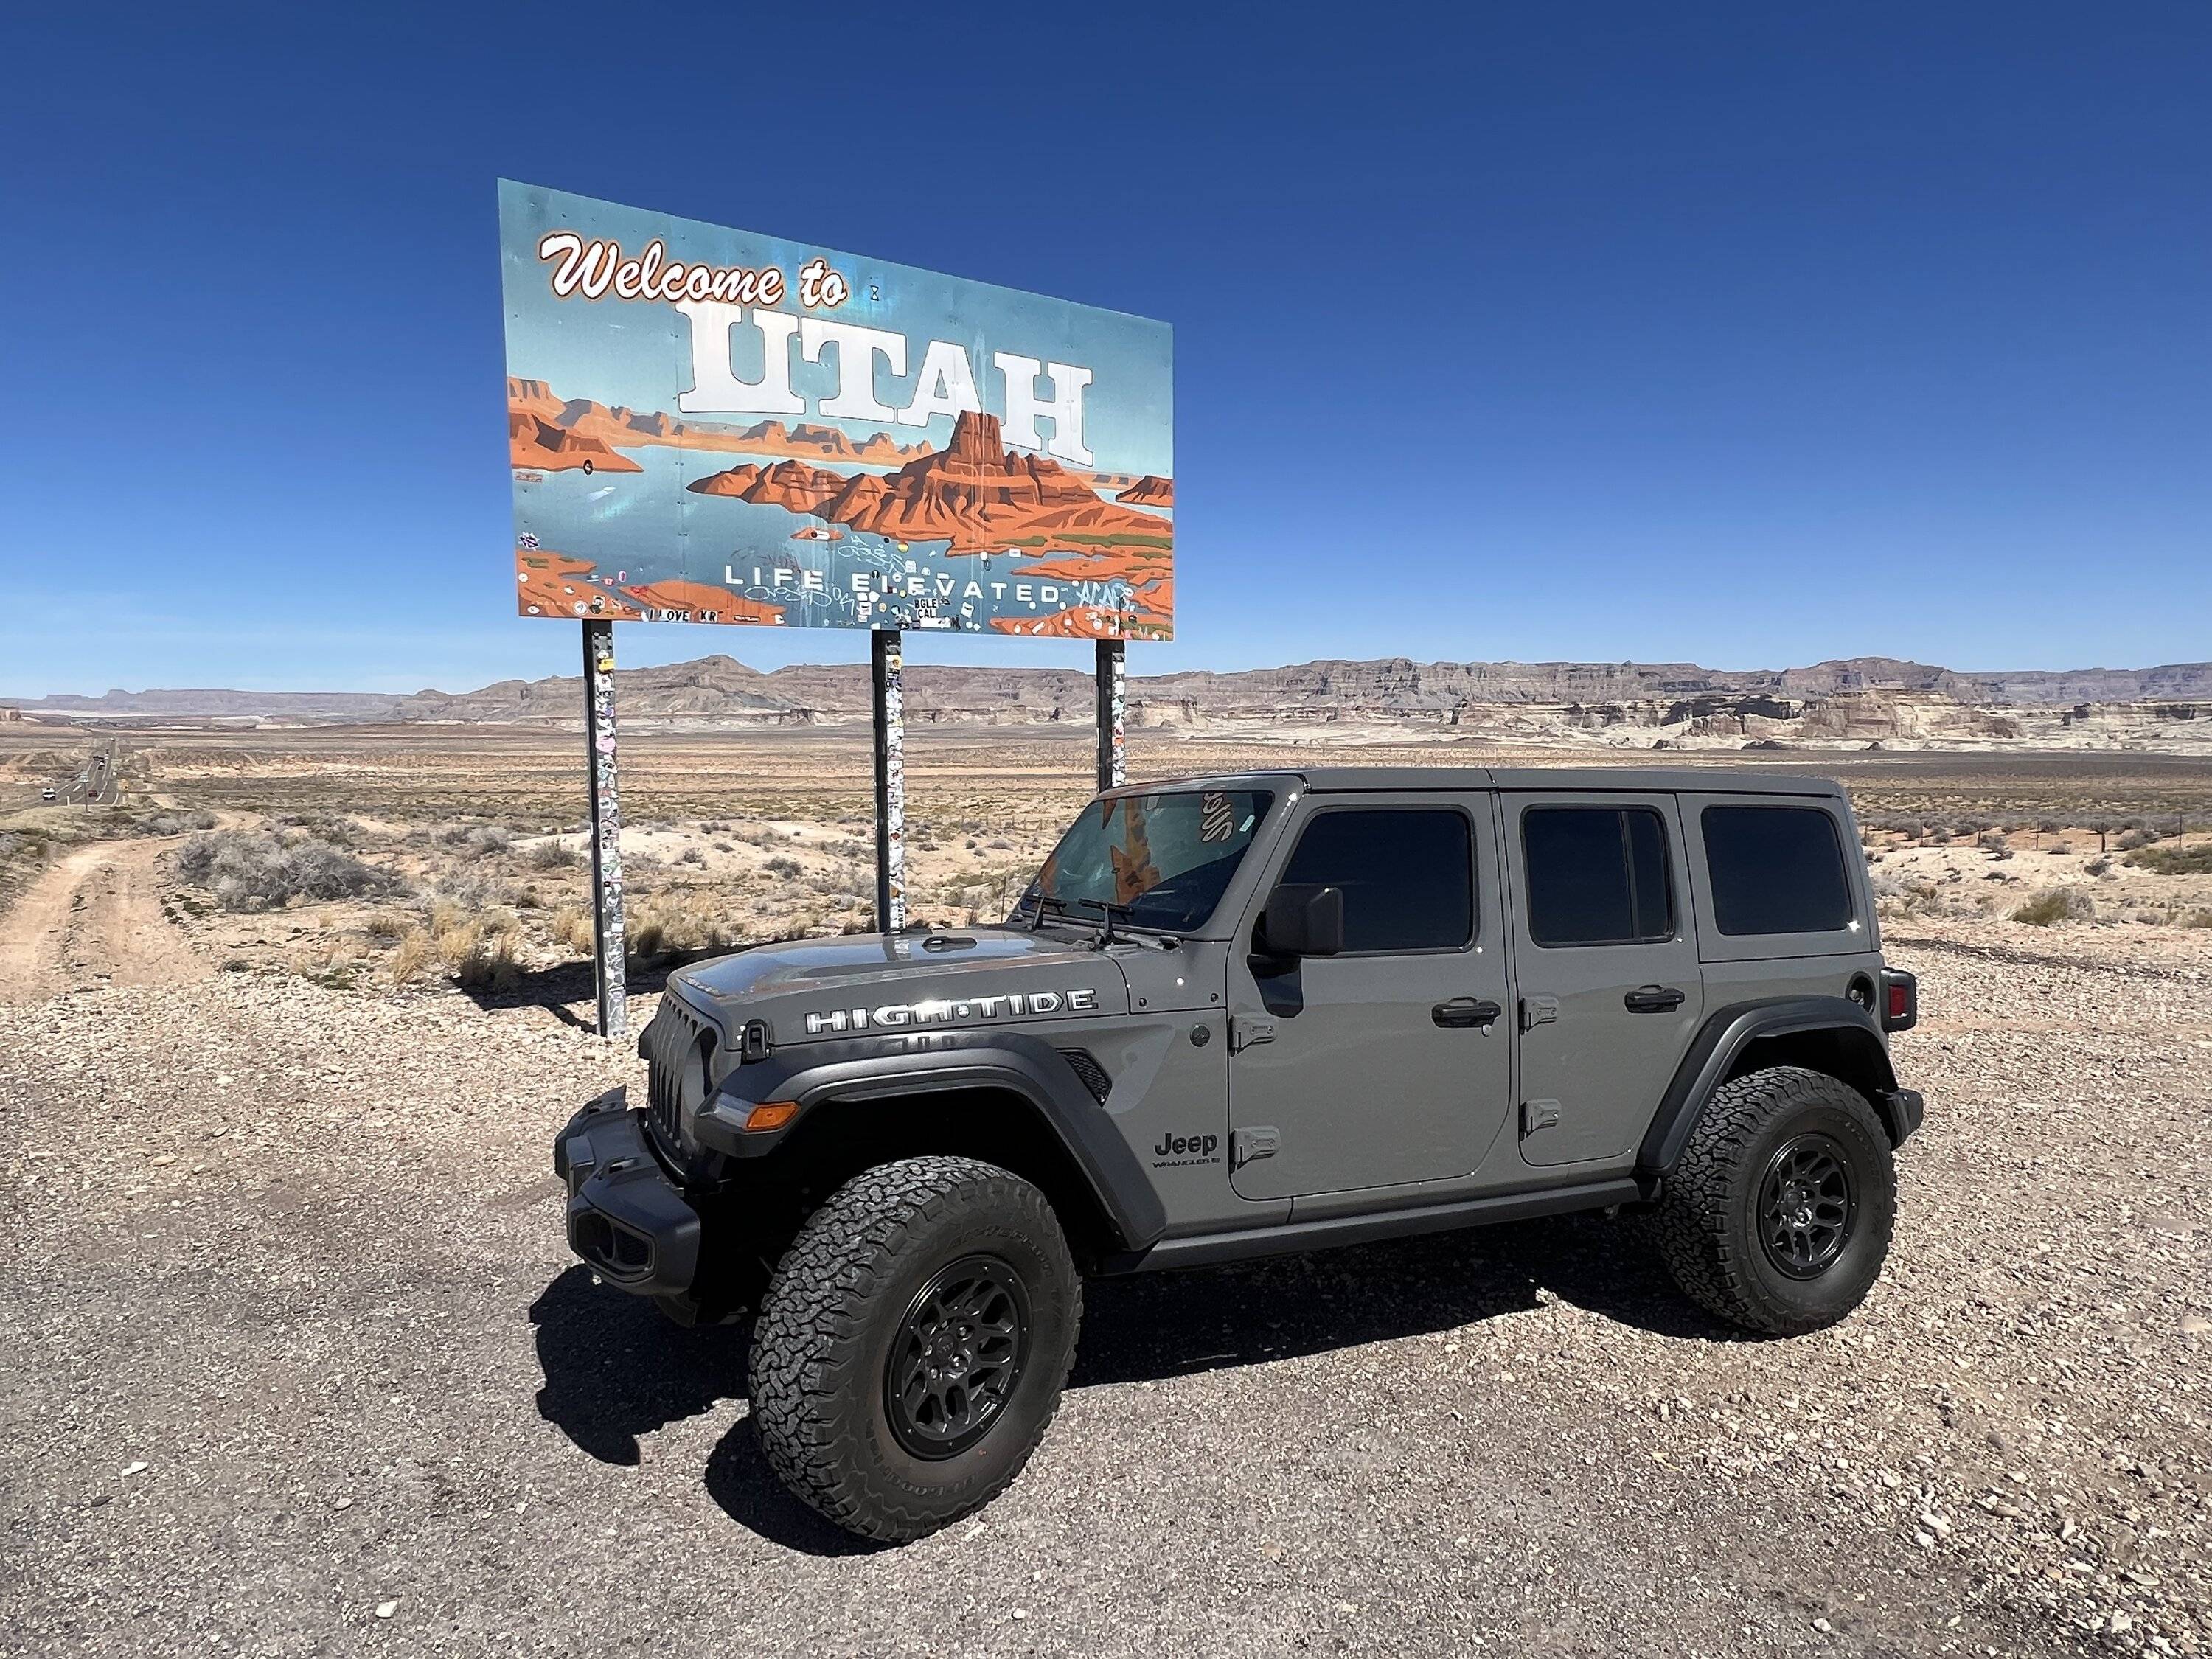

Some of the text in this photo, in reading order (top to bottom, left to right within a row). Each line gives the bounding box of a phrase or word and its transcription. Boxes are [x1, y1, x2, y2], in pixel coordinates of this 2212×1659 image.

[540, 234, 848, 307] Welcome to
[675, 299, 1094, 467] UTAH
[725, 564, 824, 591] LIFE
[851, 572, 1060, 603] ELEVATED
[1155, 1133, 1218, 1157] Jeep
